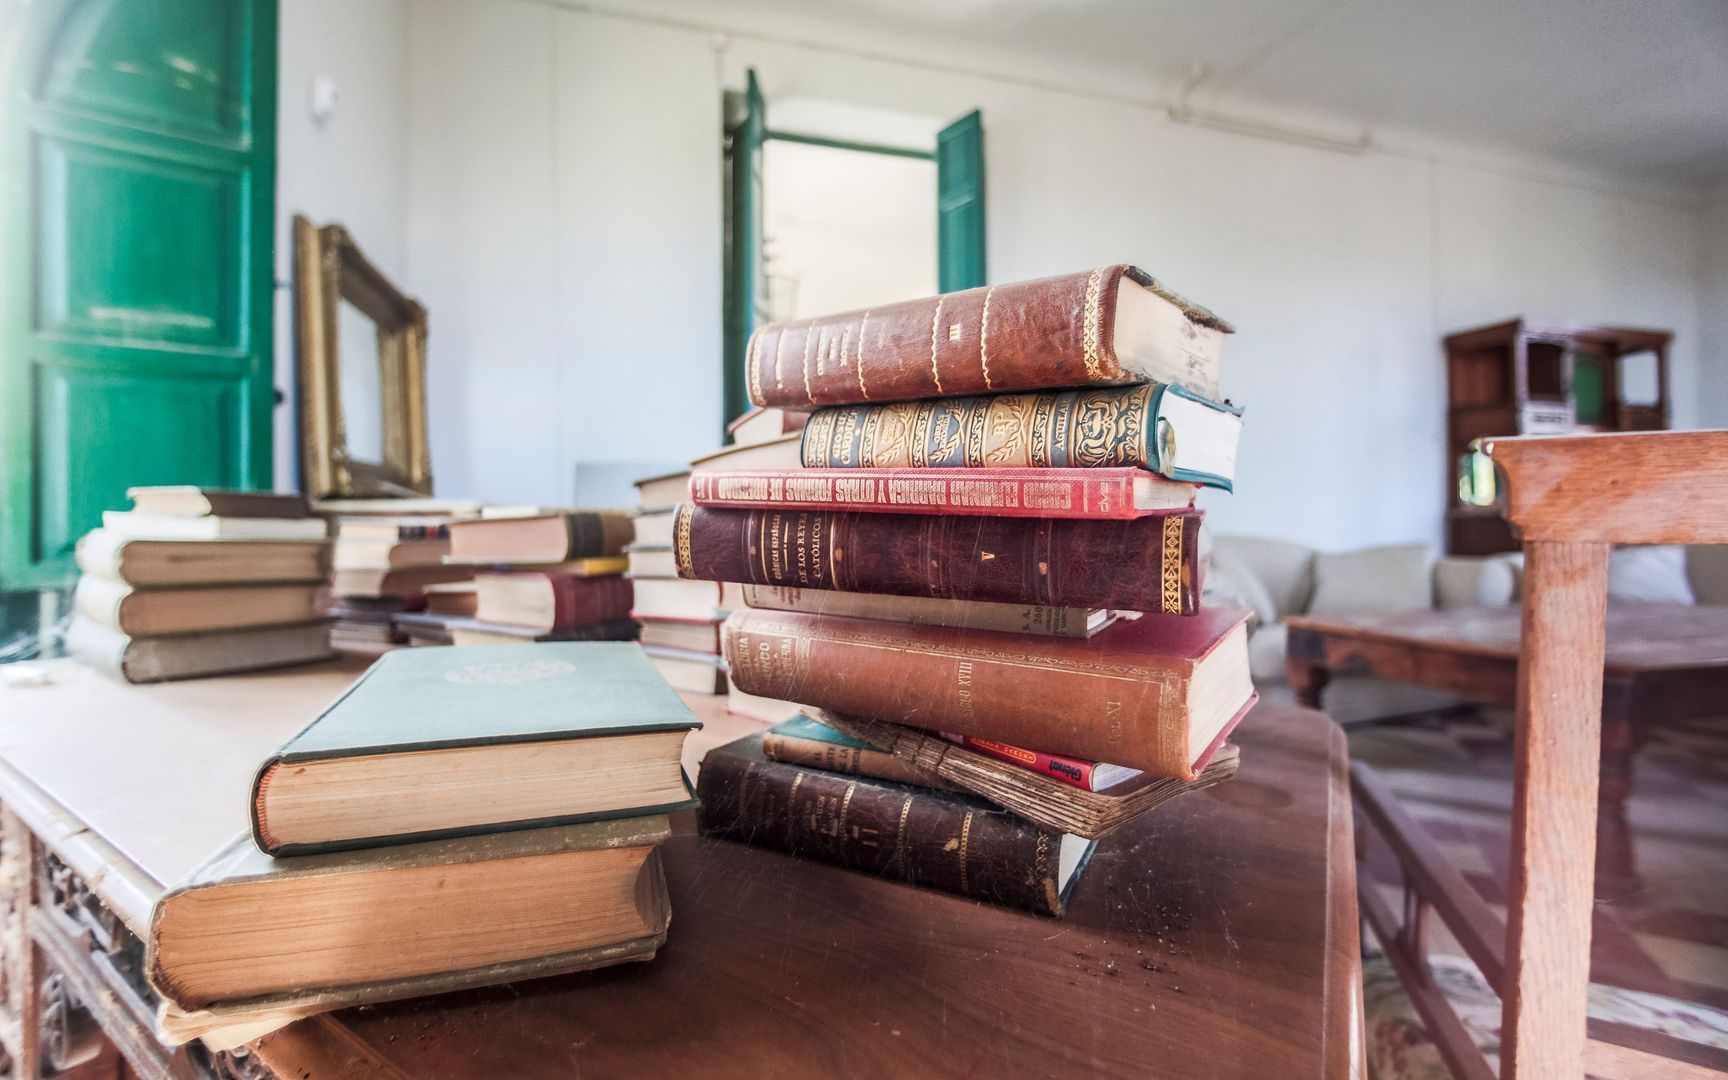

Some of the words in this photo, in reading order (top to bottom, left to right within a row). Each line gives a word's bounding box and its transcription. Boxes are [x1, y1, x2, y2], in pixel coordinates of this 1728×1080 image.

[769, 478, 784, 501] DE
[786, 478, 832, 502] FORMAS
[835, 478, 875, 503] OTRAS
[877, 479, 891, 503] Y
[797, 547, 806, 567] LOS
[810, 518, 822, 578] CATÓLICOS
[981, 551, 995, 562] V
[1048, 760, 1082, 782] Glénat
